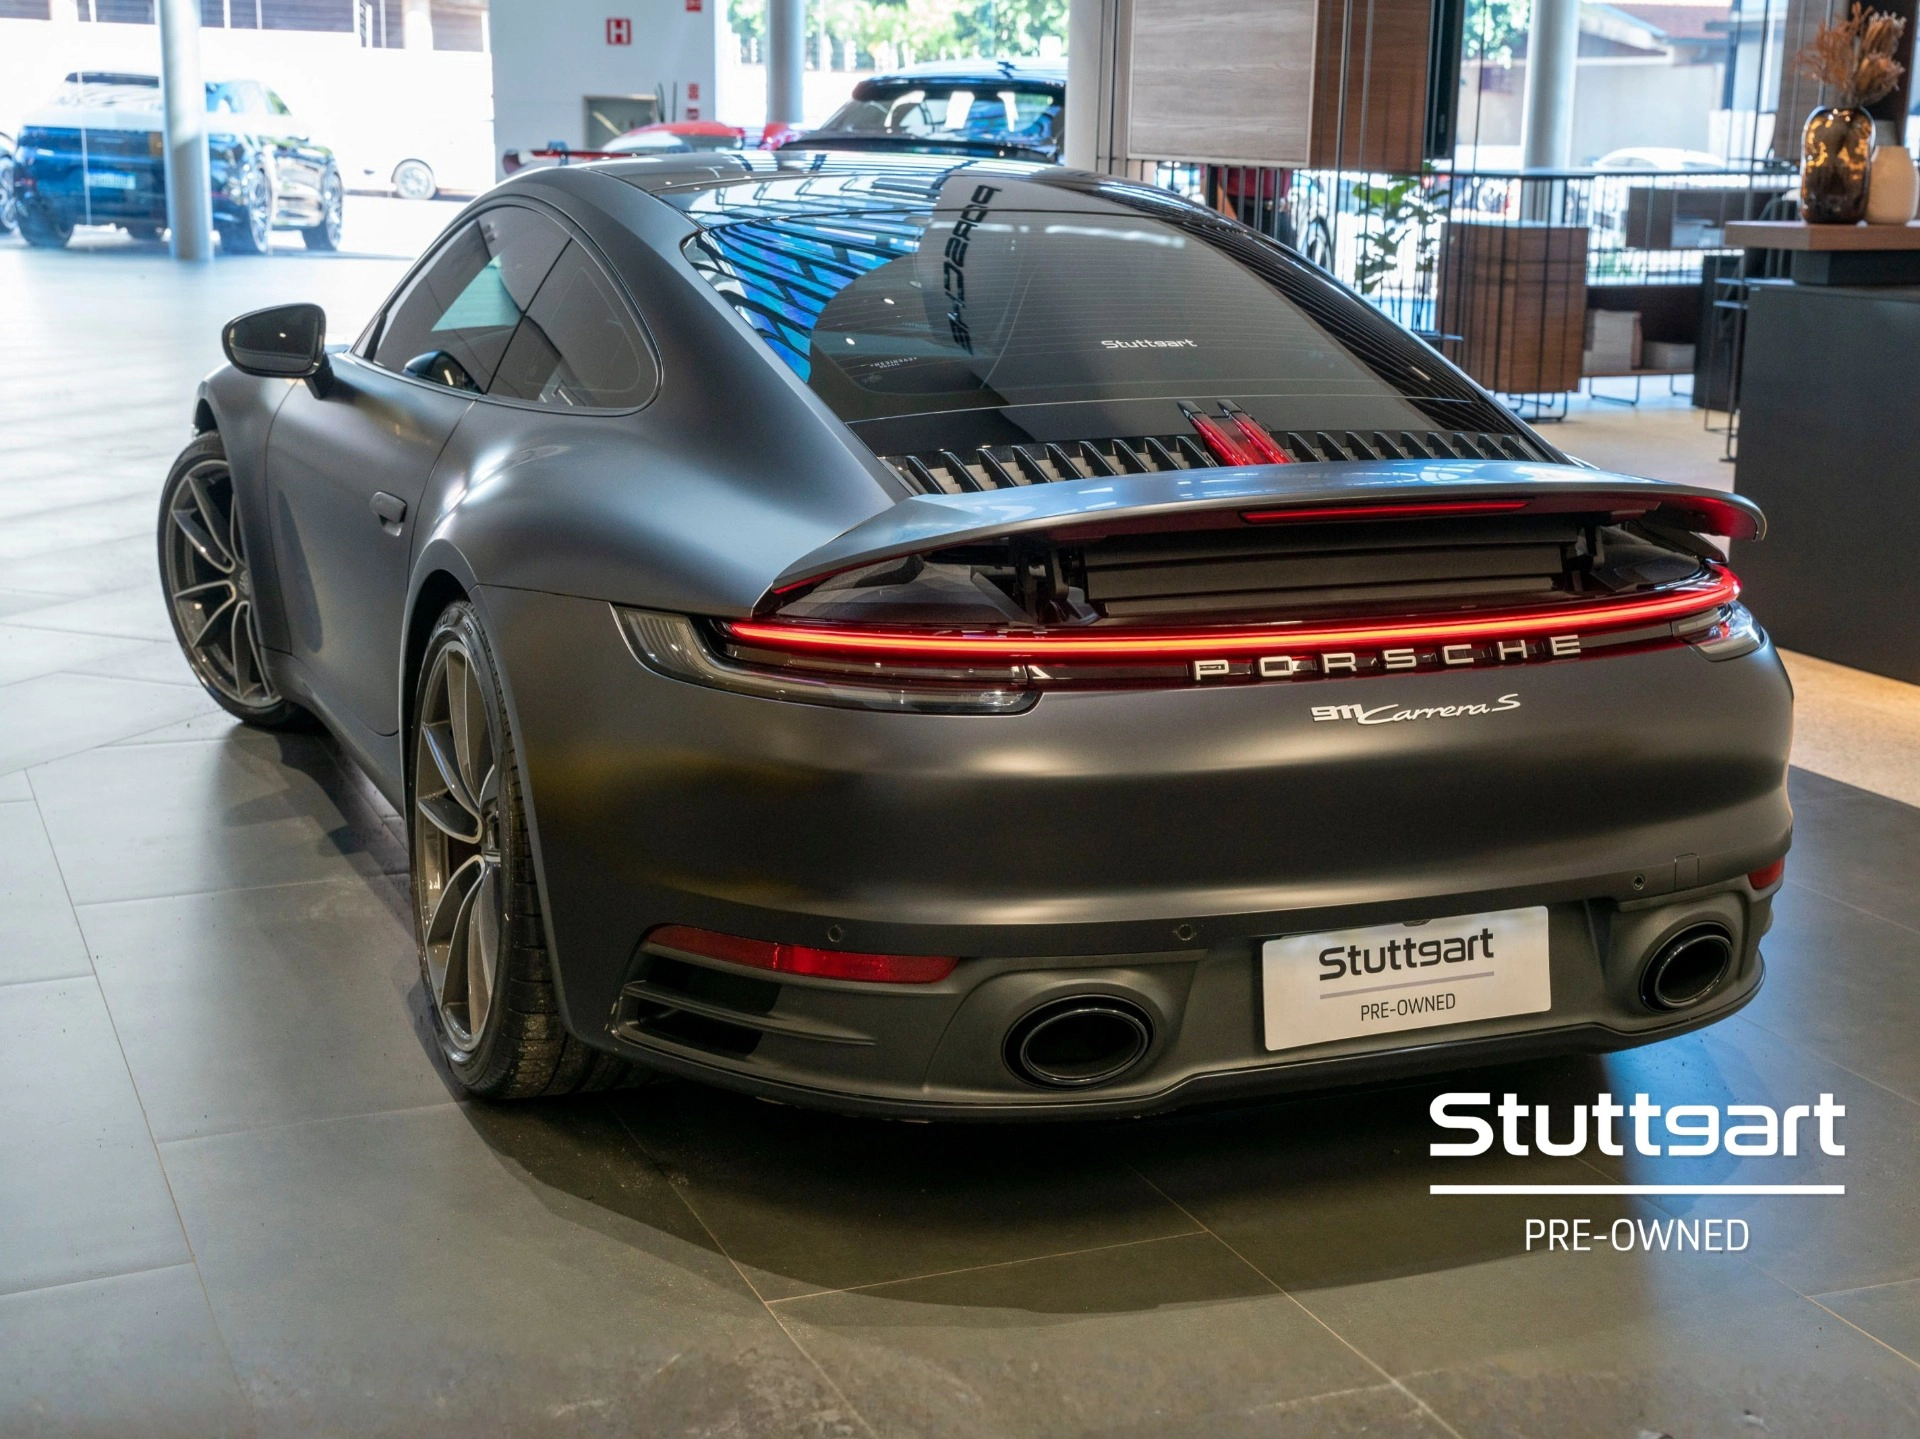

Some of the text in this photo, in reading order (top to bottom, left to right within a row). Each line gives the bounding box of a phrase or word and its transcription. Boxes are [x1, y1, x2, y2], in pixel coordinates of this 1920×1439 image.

[1100, 337, 1198, 350] Stuttgart
[1193, 634, 1581, 681] PORSCHE
[1311, 693, 1521, 725] 911 Carrera S
[1318, 928, 1495, 981] Stuttgart
[1360, 992, 1456, 1021] PRE-OWNED
